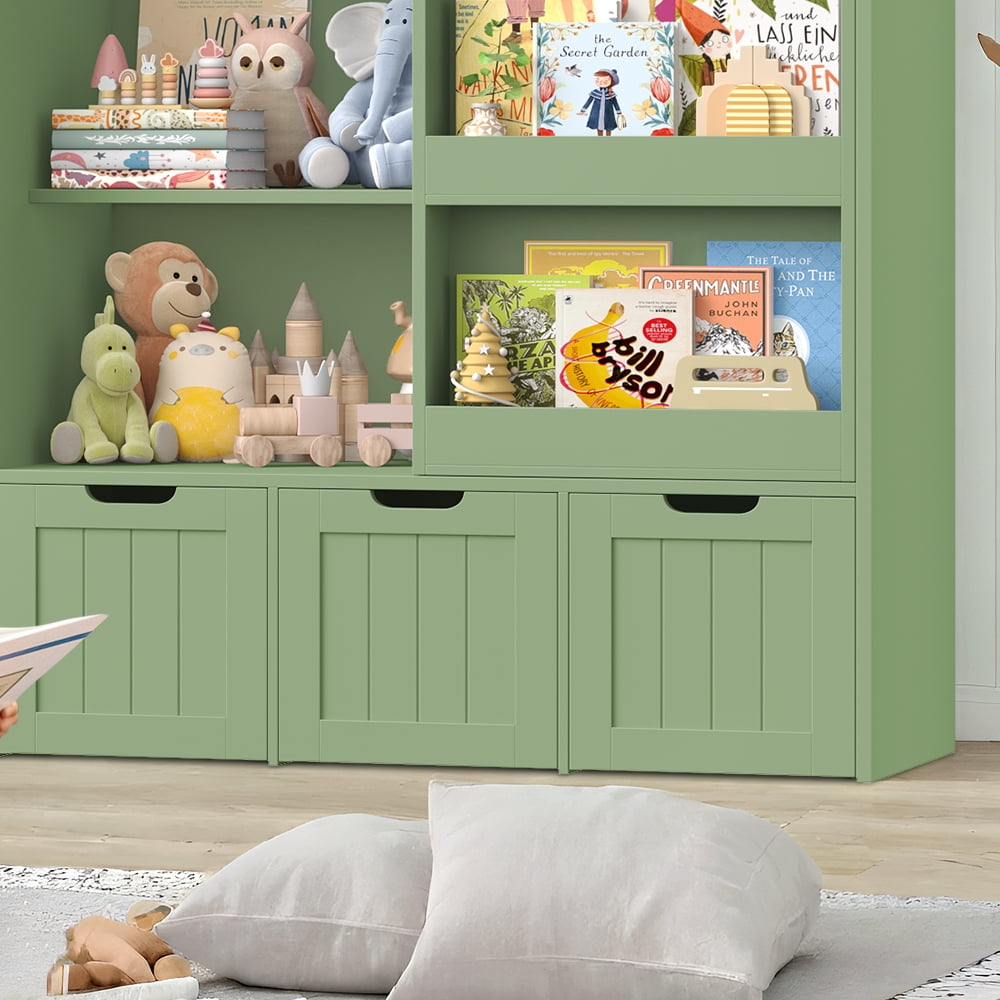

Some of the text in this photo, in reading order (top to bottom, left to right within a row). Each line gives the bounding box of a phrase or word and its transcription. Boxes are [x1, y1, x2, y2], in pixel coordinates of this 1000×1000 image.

[781, 7, 818, 20] und
[594, 34, 612, 44] the
[757, 22, 793, 44] LASS
[560, 44, 649, 57] Secret Garden
[747, 256, 813, 265] THE TALE OF
[778, 269, 836, 281] AND THE
[648, 276, 760, 297] GREENMANTLE
[613, 336, 664, 377] bill
